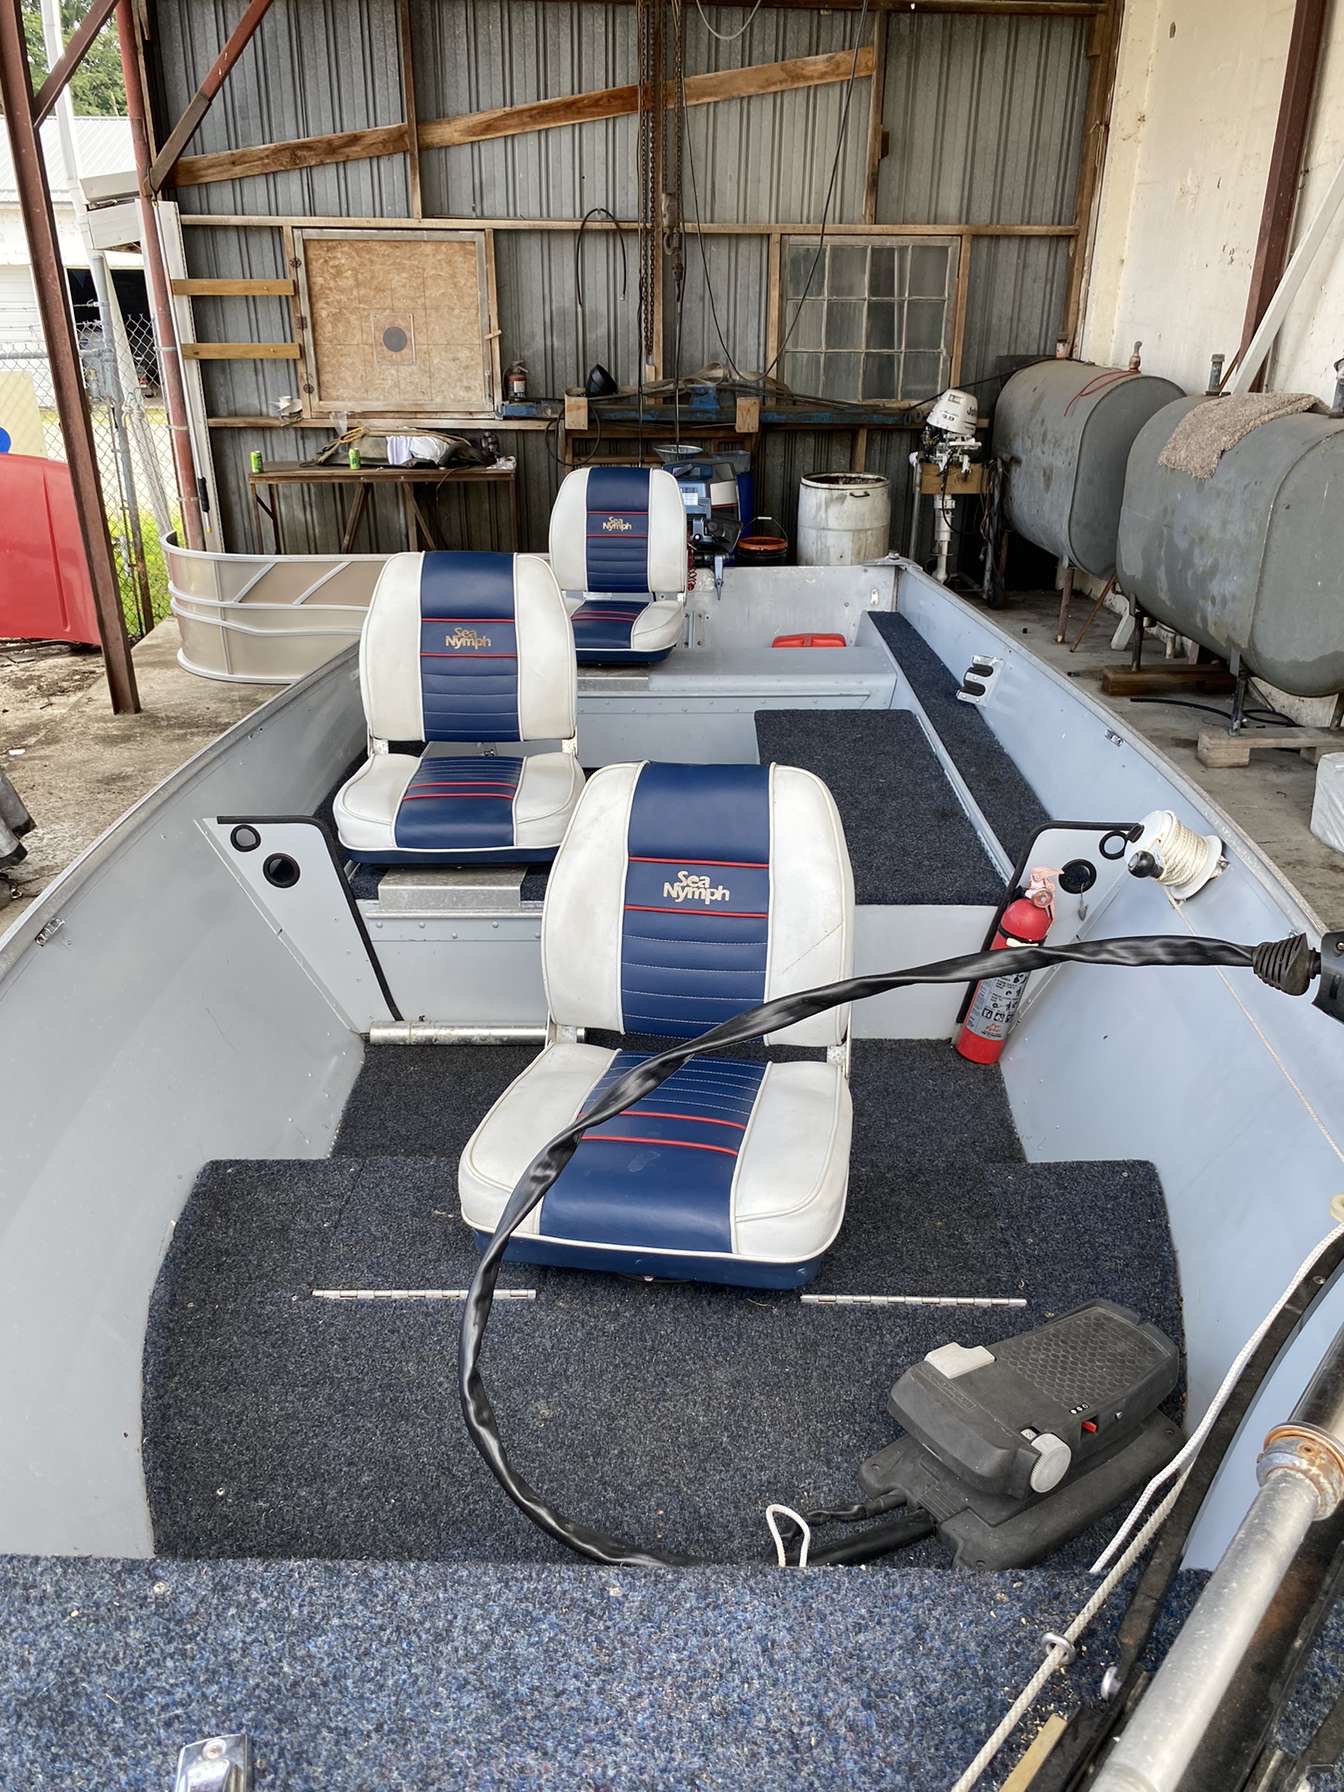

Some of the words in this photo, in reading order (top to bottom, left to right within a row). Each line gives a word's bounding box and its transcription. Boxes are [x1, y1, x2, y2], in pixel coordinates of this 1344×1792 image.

[602, 521, 632, 532] Nymph
[608, 516, 624, 526] Sea
[454, 627, 477, 639] Sea
[445, 635, 491, 650] Nymph
[677, 870, 711, 888] Sea
[663, 881, 730, 905] Nymph
